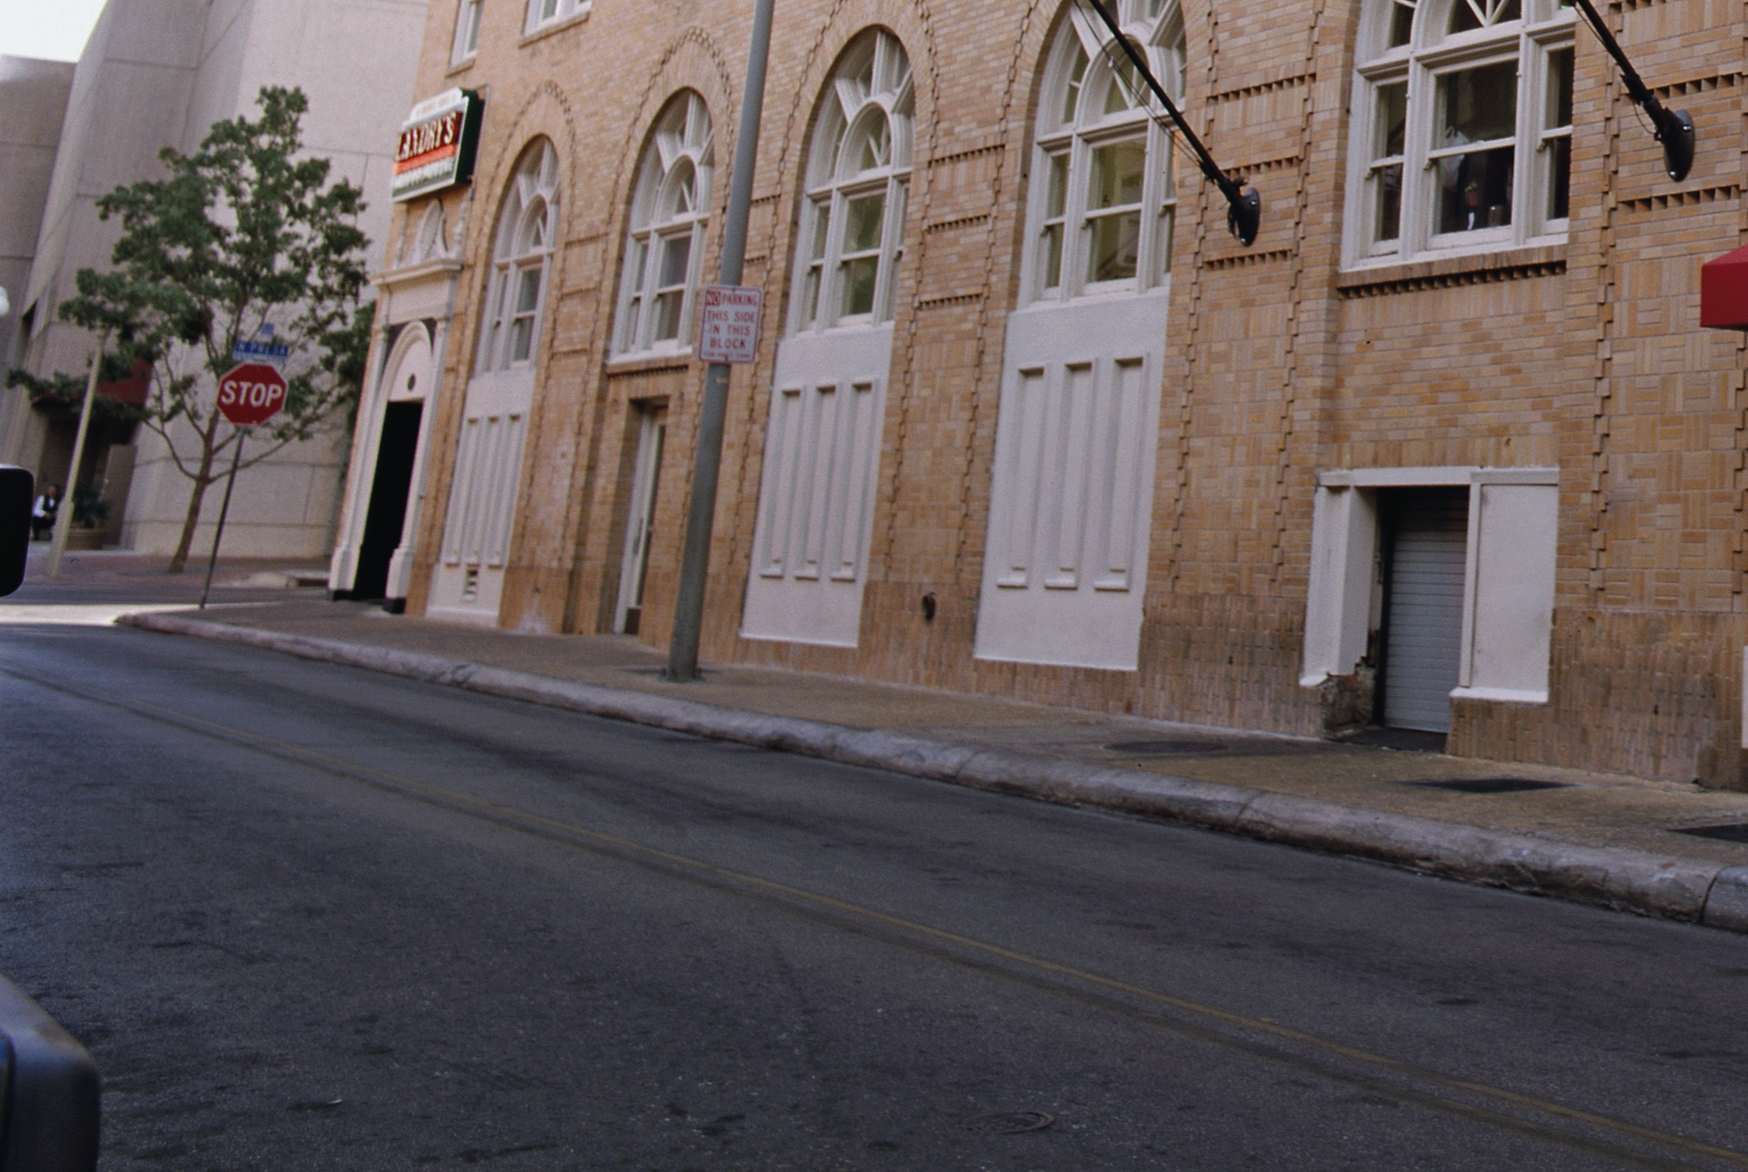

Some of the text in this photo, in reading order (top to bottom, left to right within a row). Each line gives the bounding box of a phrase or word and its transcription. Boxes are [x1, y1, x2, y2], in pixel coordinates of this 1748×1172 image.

[706, 291, 758, 306] NO PARKING
[707, 310, 754, 322] THIS SIDE
[709, 324, 751, 336] IN THIS
[710, 337, 746, 349] BLOCK
[221, 380, 283, 407] STOP
